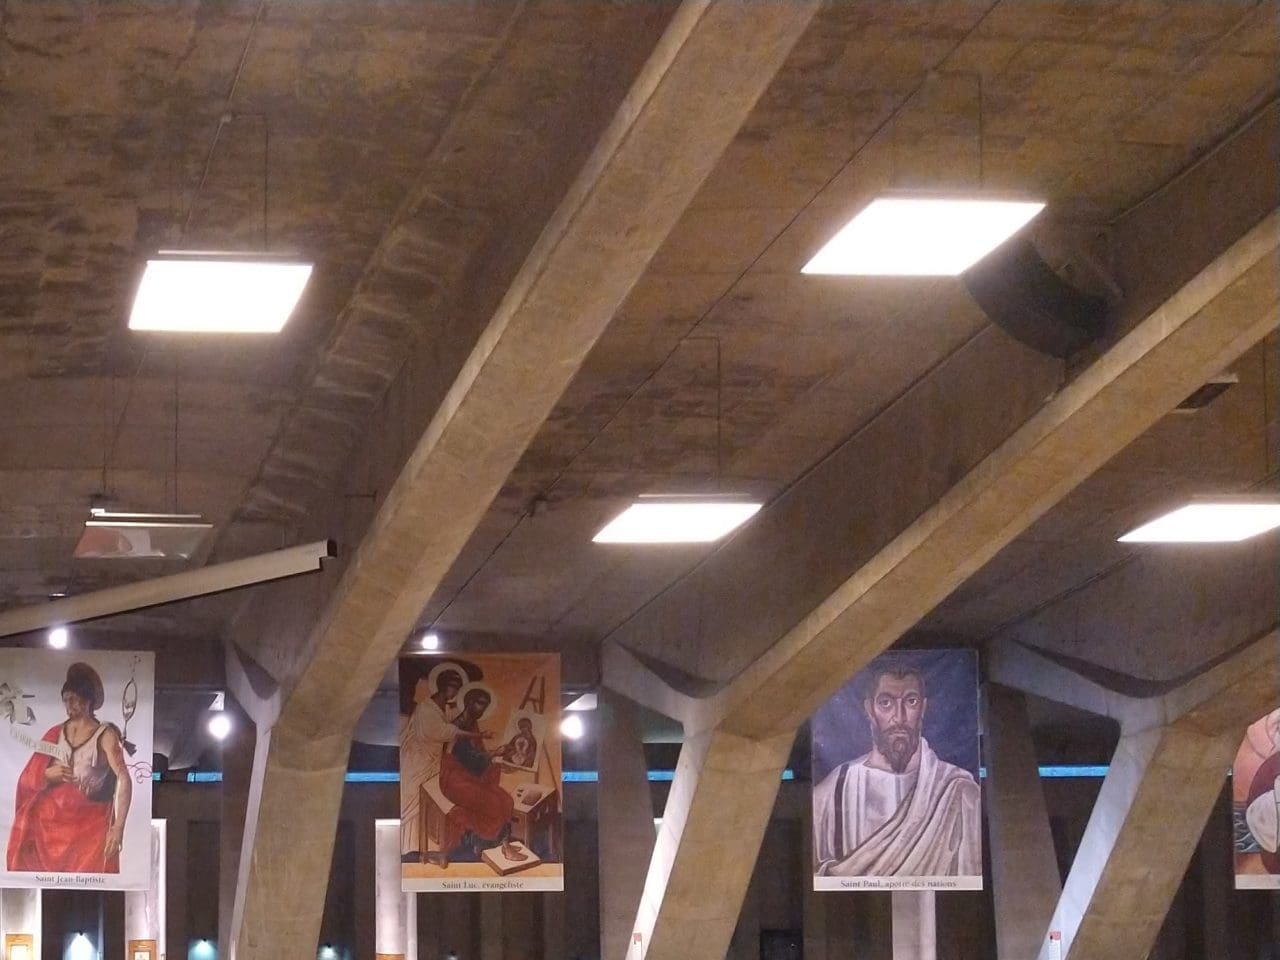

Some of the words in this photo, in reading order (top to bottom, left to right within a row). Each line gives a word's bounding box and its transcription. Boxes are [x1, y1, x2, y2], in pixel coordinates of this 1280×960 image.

[442, 881, 461, 889] Saint
[840, 880, 860, 888] Saint
[927, 880, 957, 888] nations
